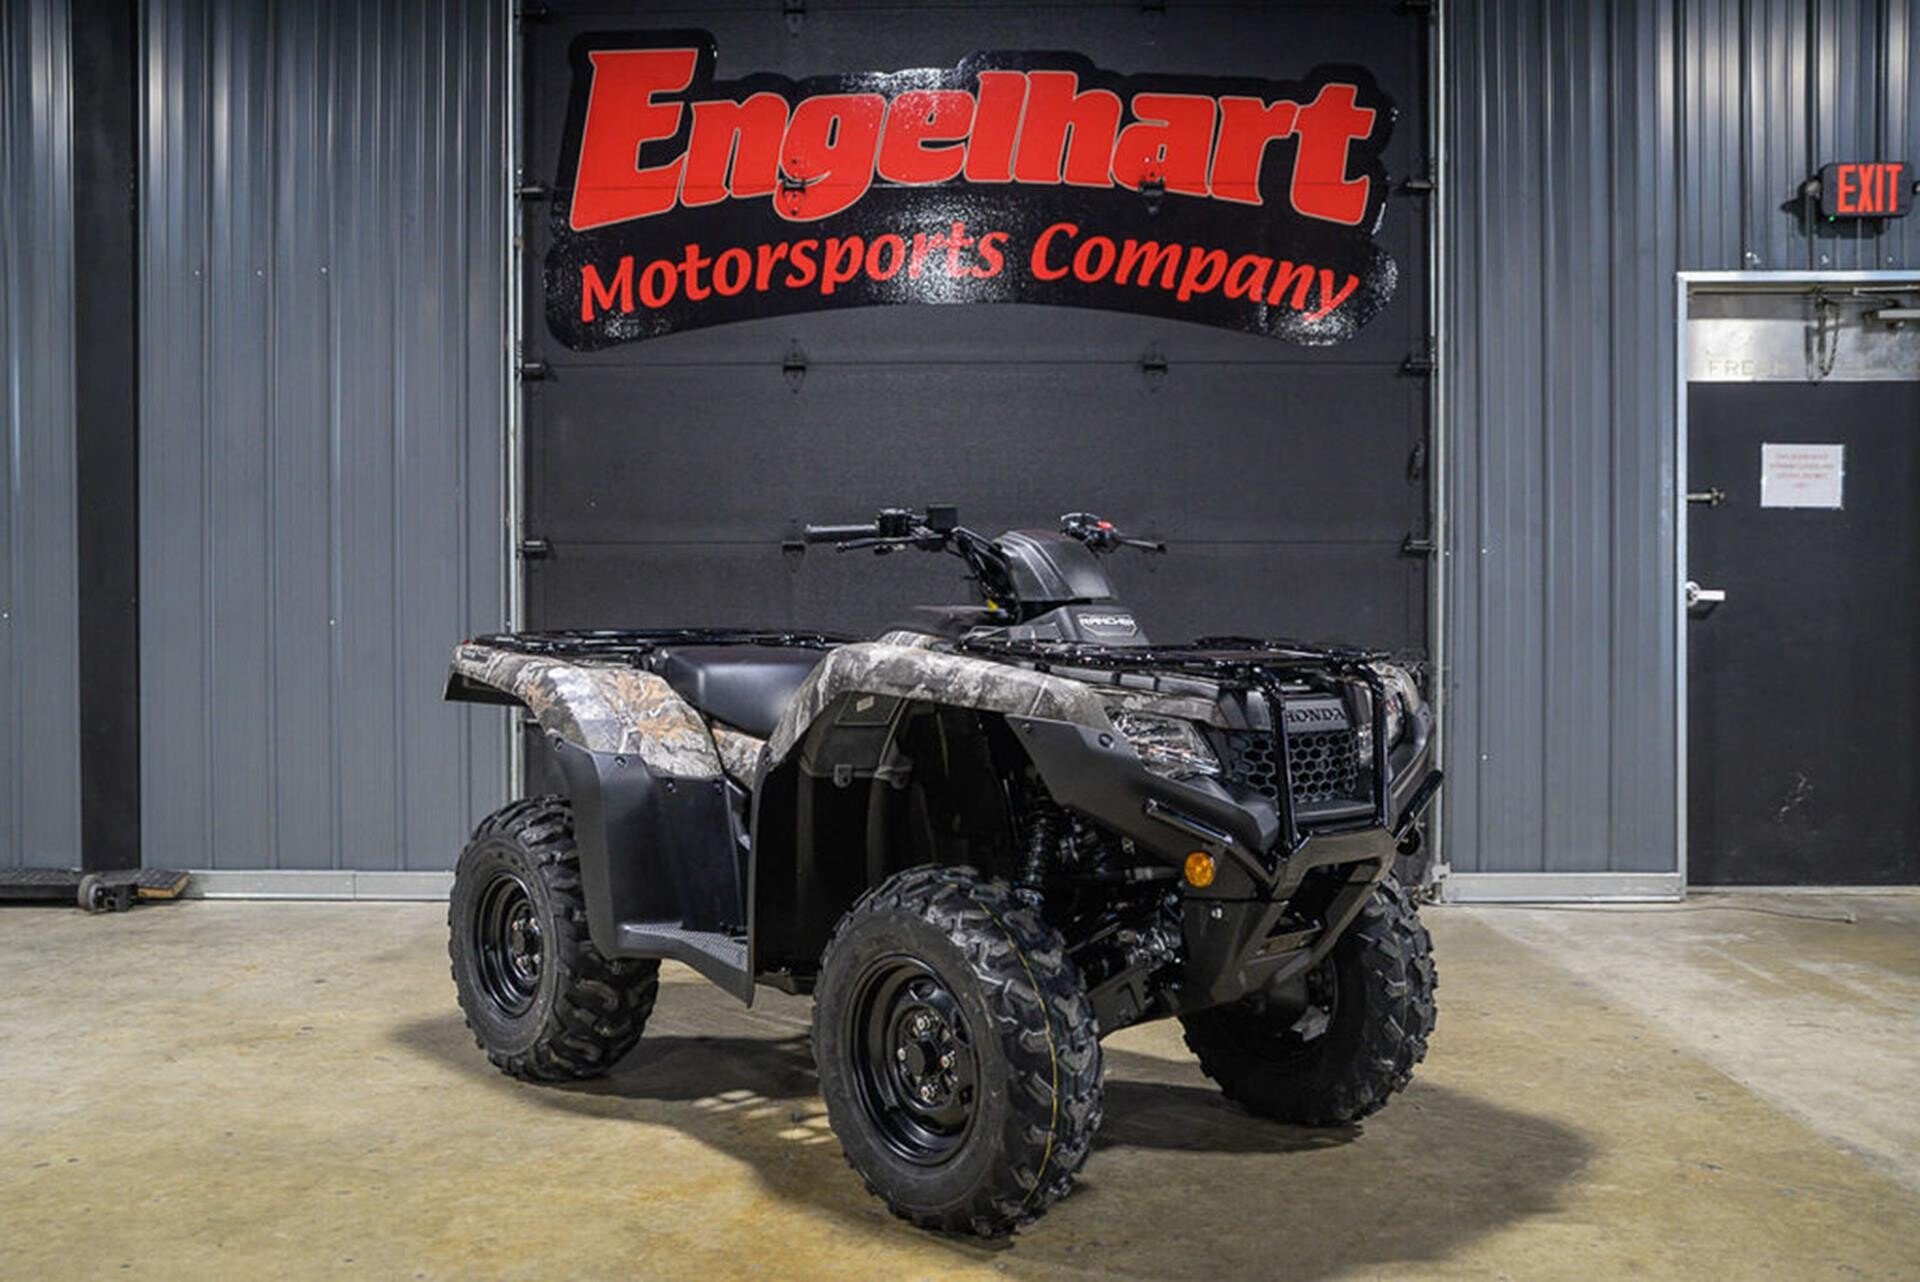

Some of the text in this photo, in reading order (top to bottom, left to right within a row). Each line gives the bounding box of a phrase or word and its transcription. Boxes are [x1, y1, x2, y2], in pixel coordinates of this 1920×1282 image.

[569, 48, 1376, 231] Engelhart
[1837, 164, 1904, 213] EXIT
[580, 221, 1359, 322] Motorsports Company
